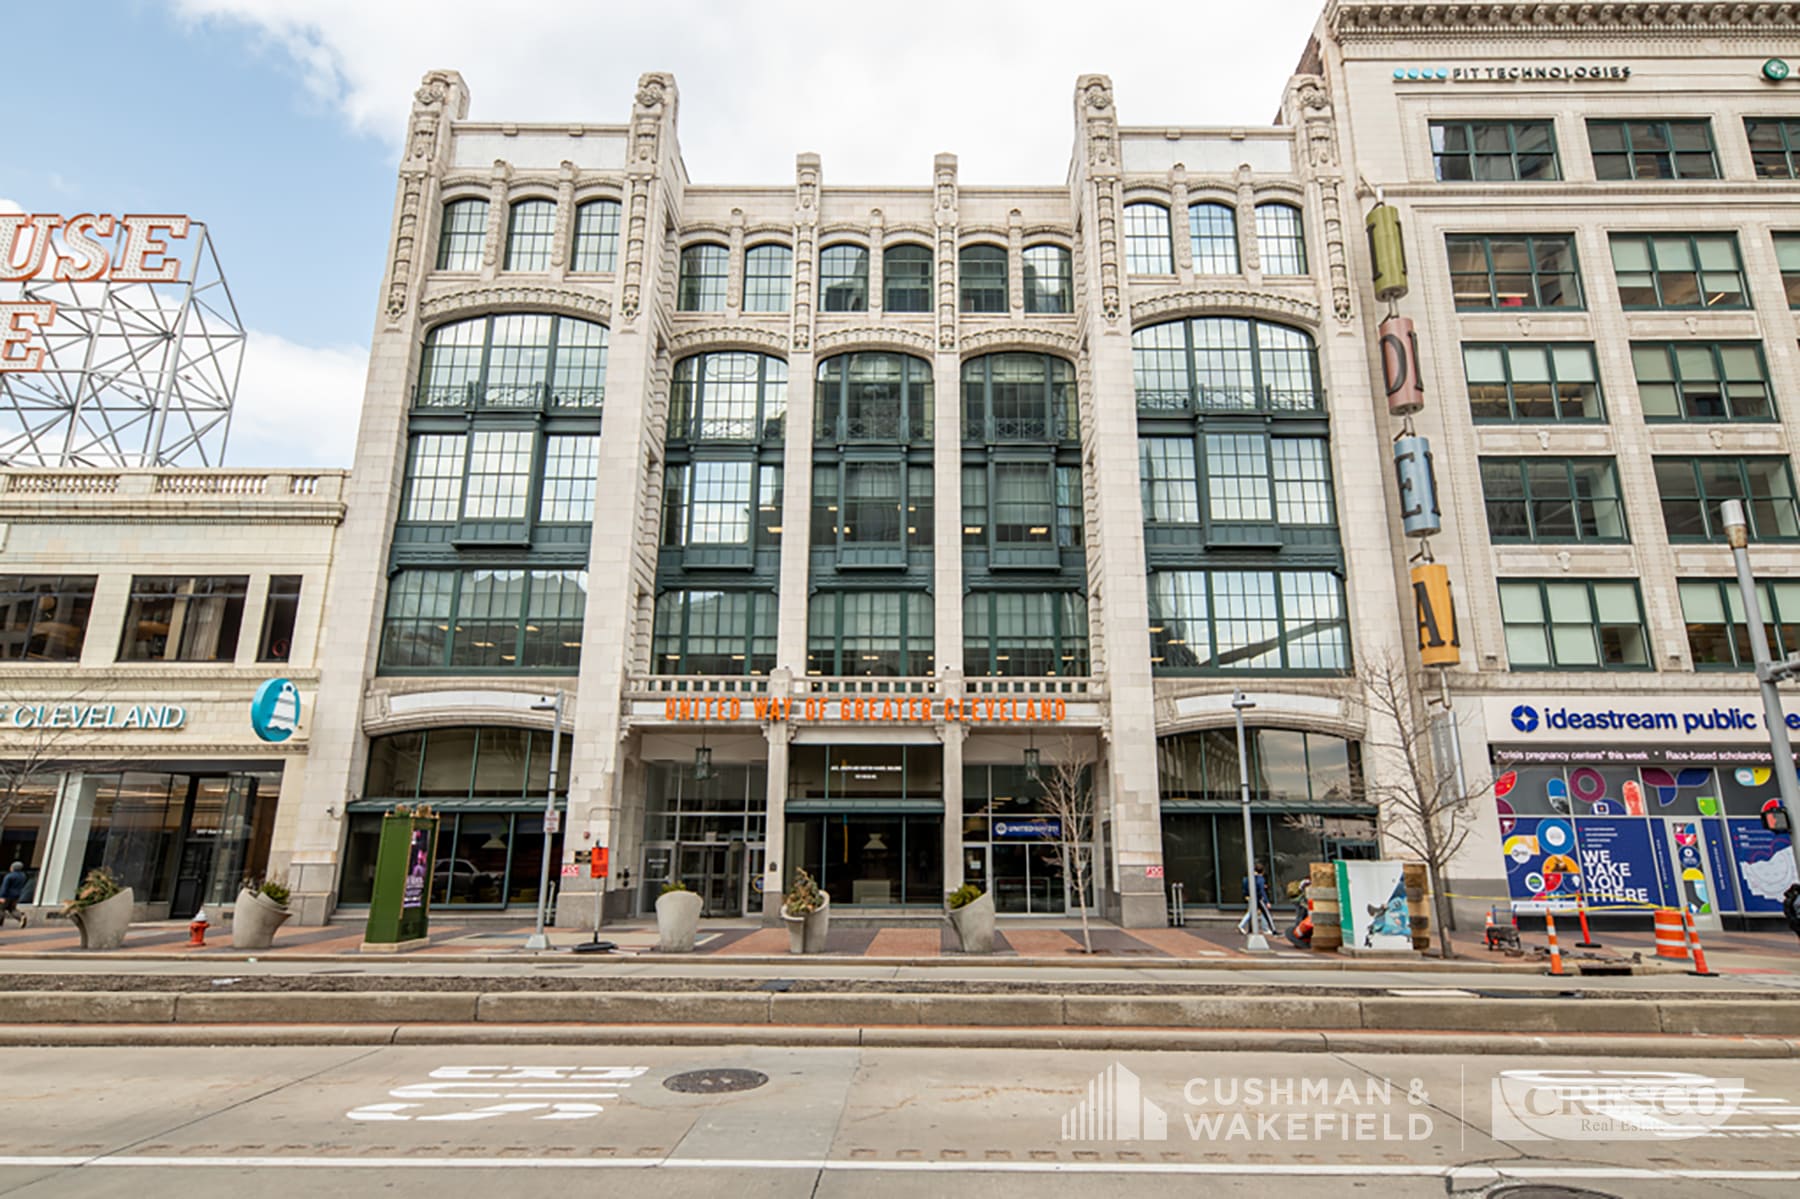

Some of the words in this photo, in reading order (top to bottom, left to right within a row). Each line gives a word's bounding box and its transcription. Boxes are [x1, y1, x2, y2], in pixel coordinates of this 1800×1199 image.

[1453, 67, 1480, 79] FIT
[1485, 66, 1632, 79] TECHNOLOGIES
[665, 696, 741, 721] UNITED
[753, 696, 794, 721] WAY
[805, 697, 829, 721] OF
[840, 697, 933, 722] GREATER
[944, 697, 1067, 722] CLEVELAND
[13, 704, 187, 729] CLEVELAND
[1544, 707, 1678, 729] ideastream
[1683, 708, 1757, 734] public
[1525, 752, 1570, 762] pregnancy
[1607, 751, 1625, 760] this
[1626, 752, 1649, 760] week
[1665, 751, 1718, 760] Race-based
[1719, 751, 1773, 762] scholarships
[1582, 850, 1611, 863] WE
[1584, 863, 1632, 877] TAKE
[1586, 875, 1625, 889] YOU
[1588, 888, 1649, 902] THERE
[346, 1066, 649, 1121] BUS
